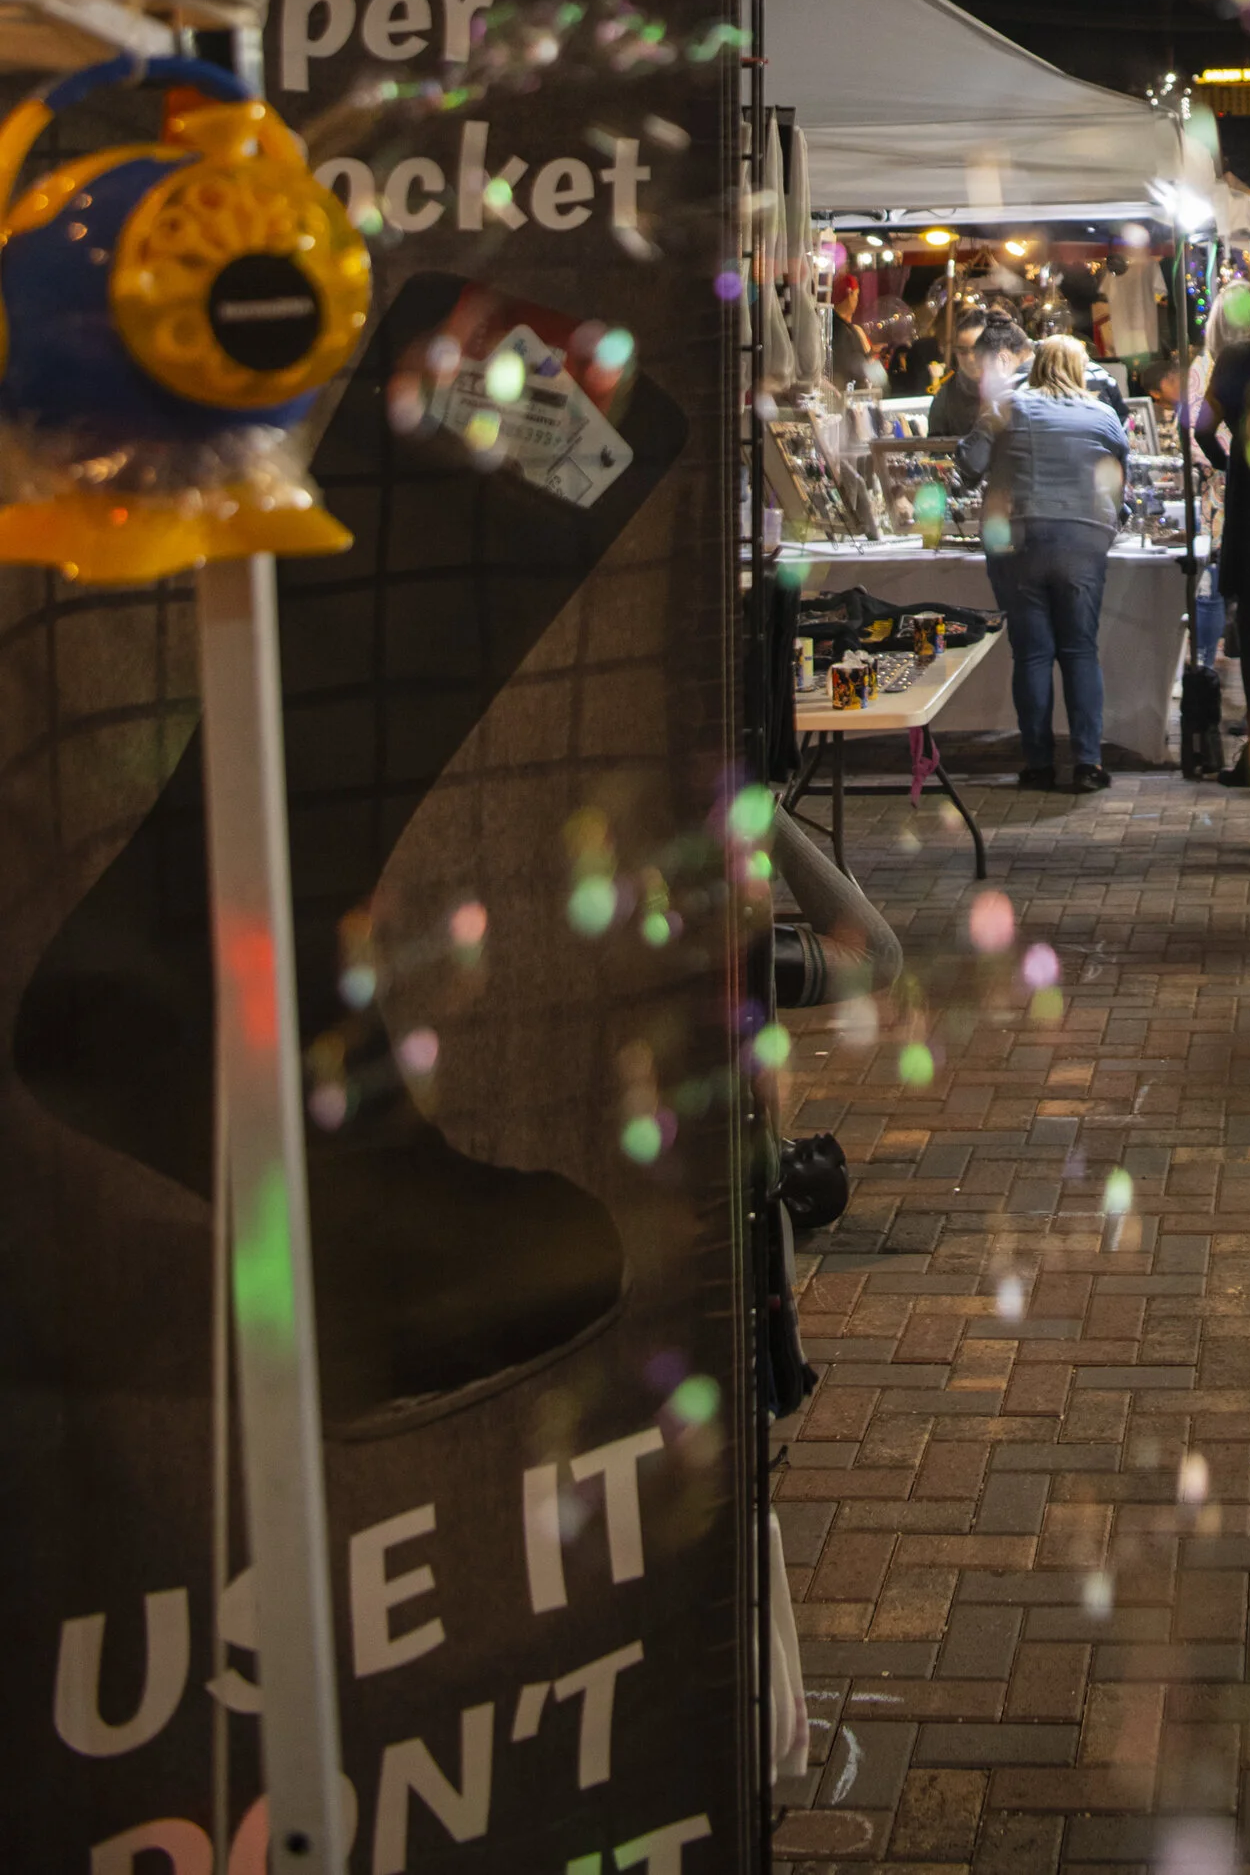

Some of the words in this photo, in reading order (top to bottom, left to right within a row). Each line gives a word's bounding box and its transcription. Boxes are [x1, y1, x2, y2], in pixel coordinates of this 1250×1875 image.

[313, 119, 652, 233] ocket
[522, 1427, 665, 1615] IT
[90, 1640, 644, 1875] N'T
